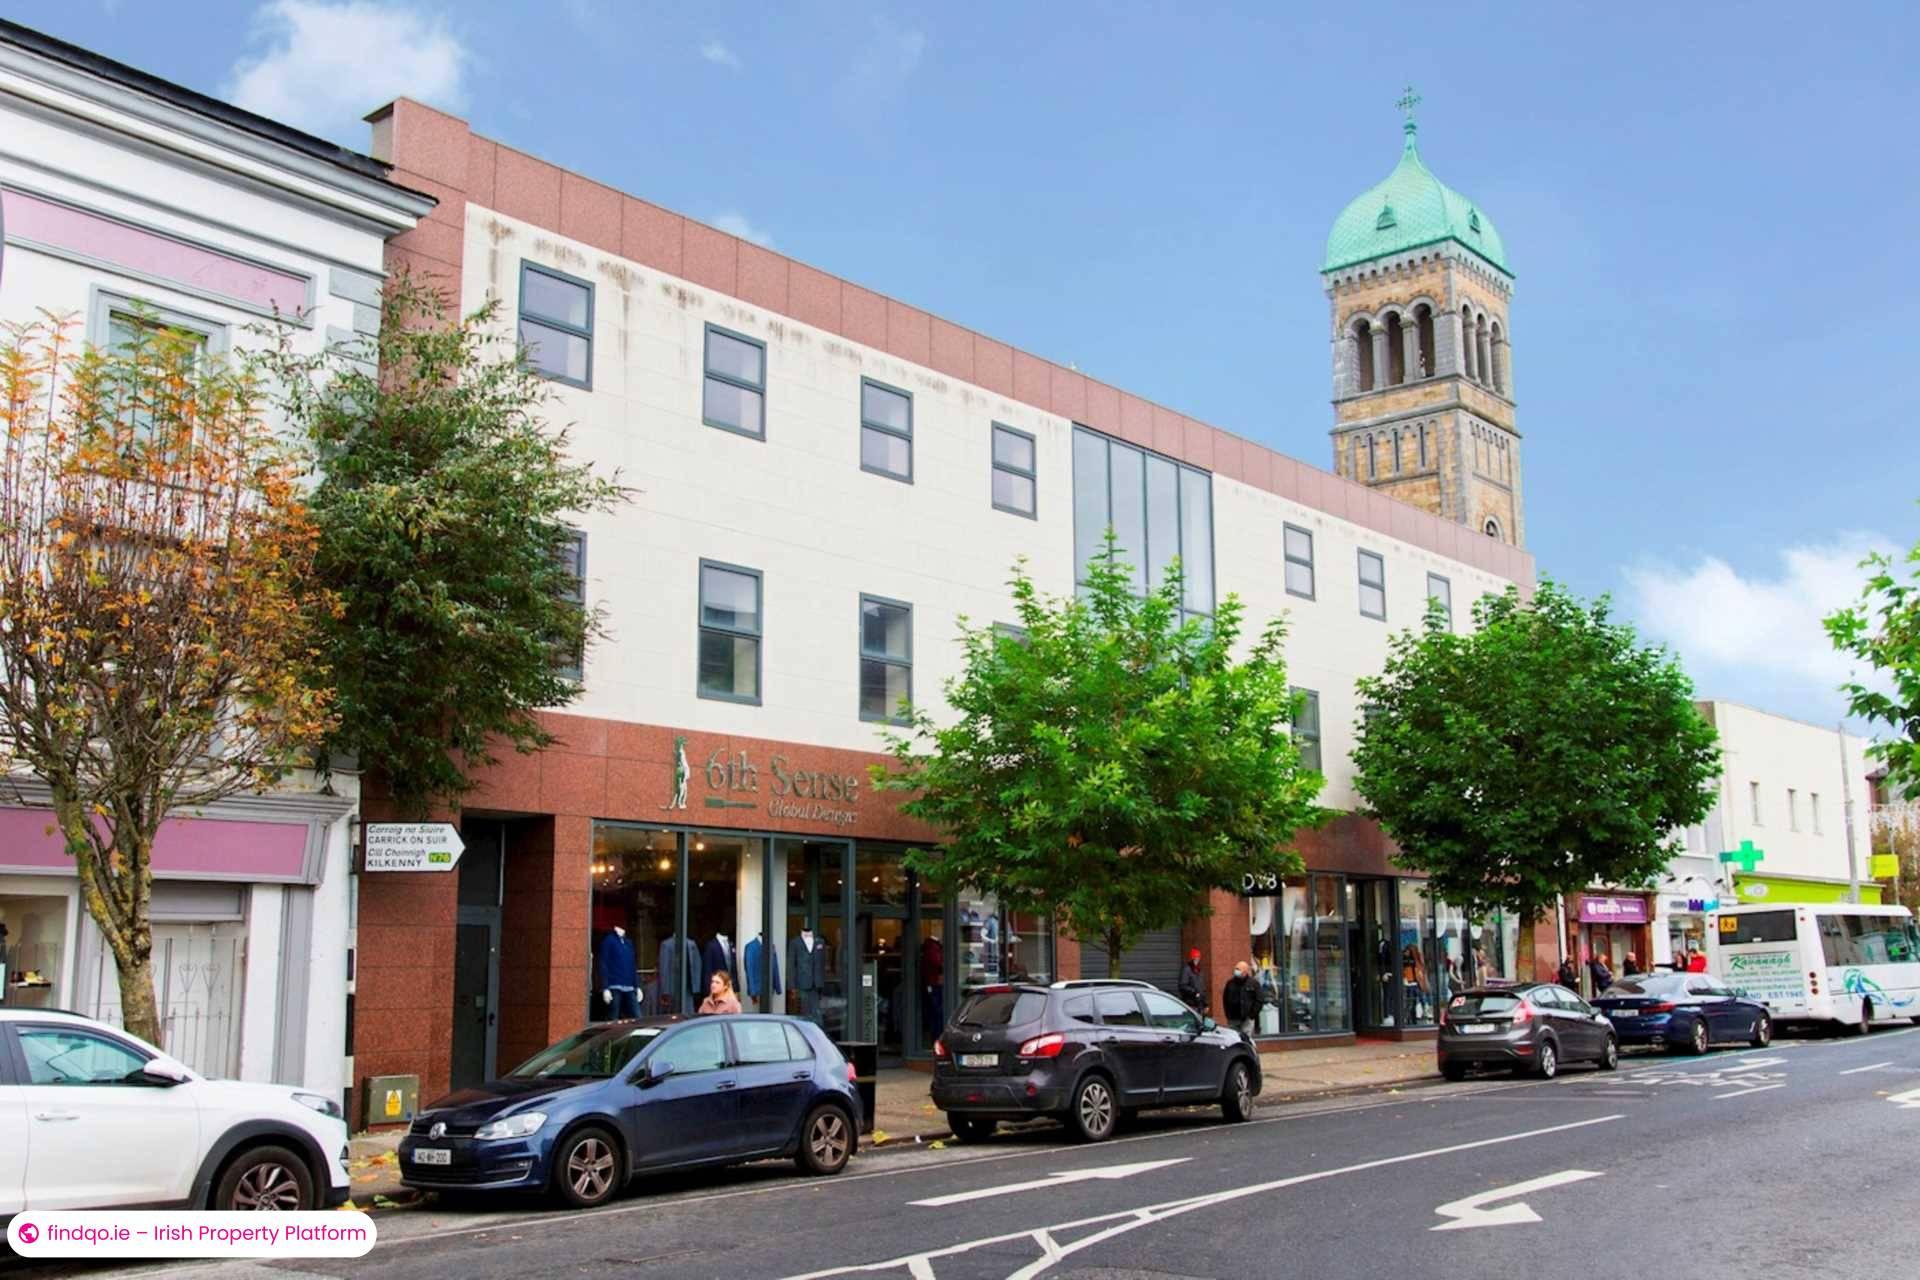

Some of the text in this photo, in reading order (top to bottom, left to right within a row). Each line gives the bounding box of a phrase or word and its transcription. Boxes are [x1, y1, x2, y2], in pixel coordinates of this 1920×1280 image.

[706, 749, 859, 804] 6th Sense
[768, 799, 809, 819] Global
[368, 836, 447, 844] CARRICK ON SUIR
[367, 859, 422, 867] KILKENNY
[1729, 952, 1792, 970] Kavanagh
